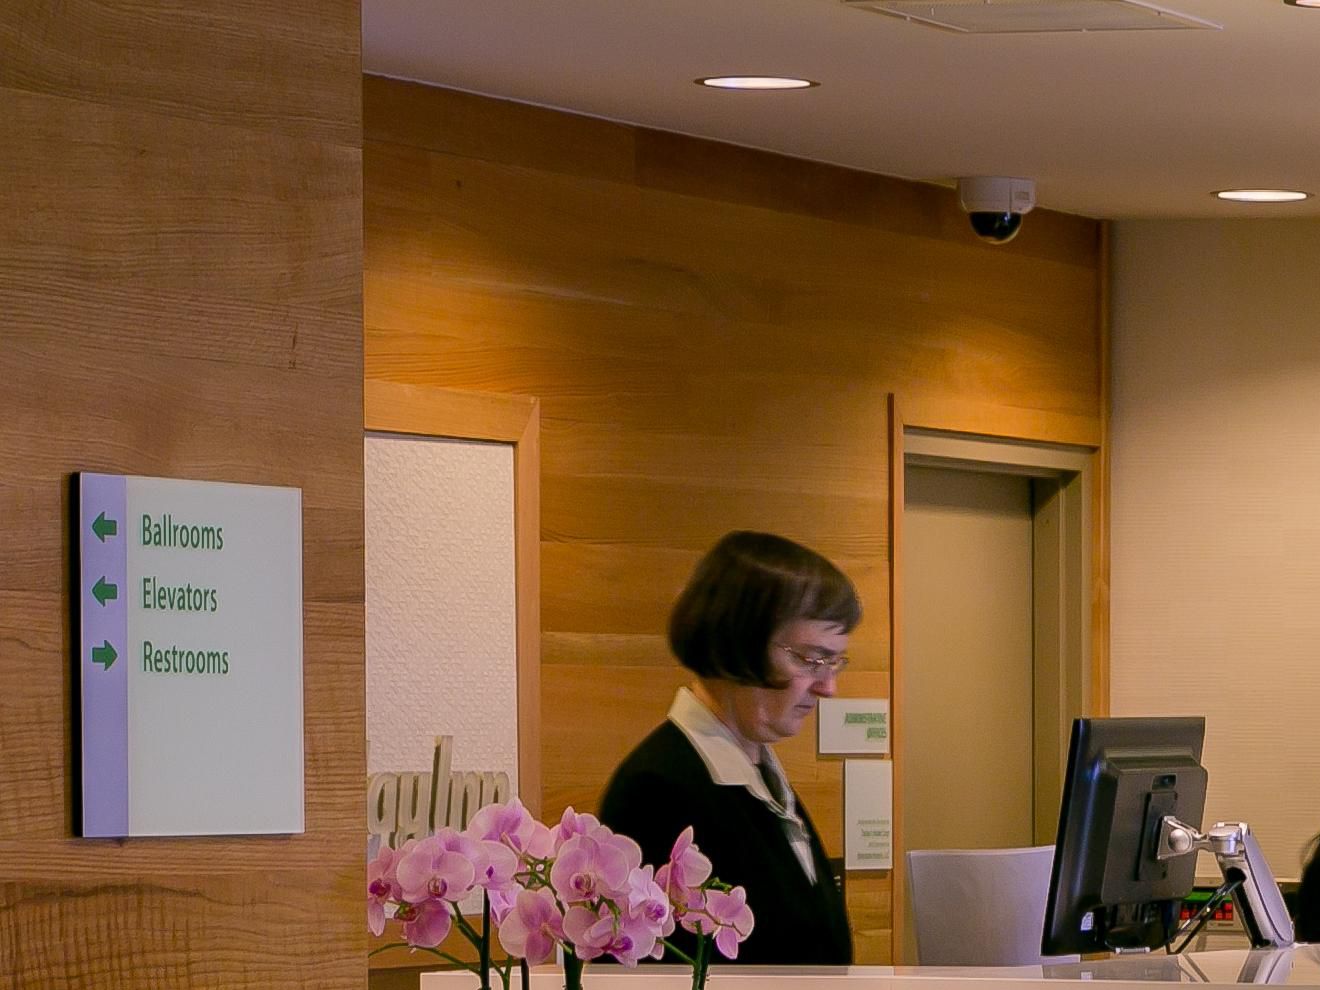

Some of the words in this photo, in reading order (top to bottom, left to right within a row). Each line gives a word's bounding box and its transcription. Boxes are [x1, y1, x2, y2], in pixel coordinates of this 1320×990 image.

[142, 514, 224, 550] Ballrooms
[142, 576, 218, 612] Elevators
[143, 640, 229, 674] Restrooms
